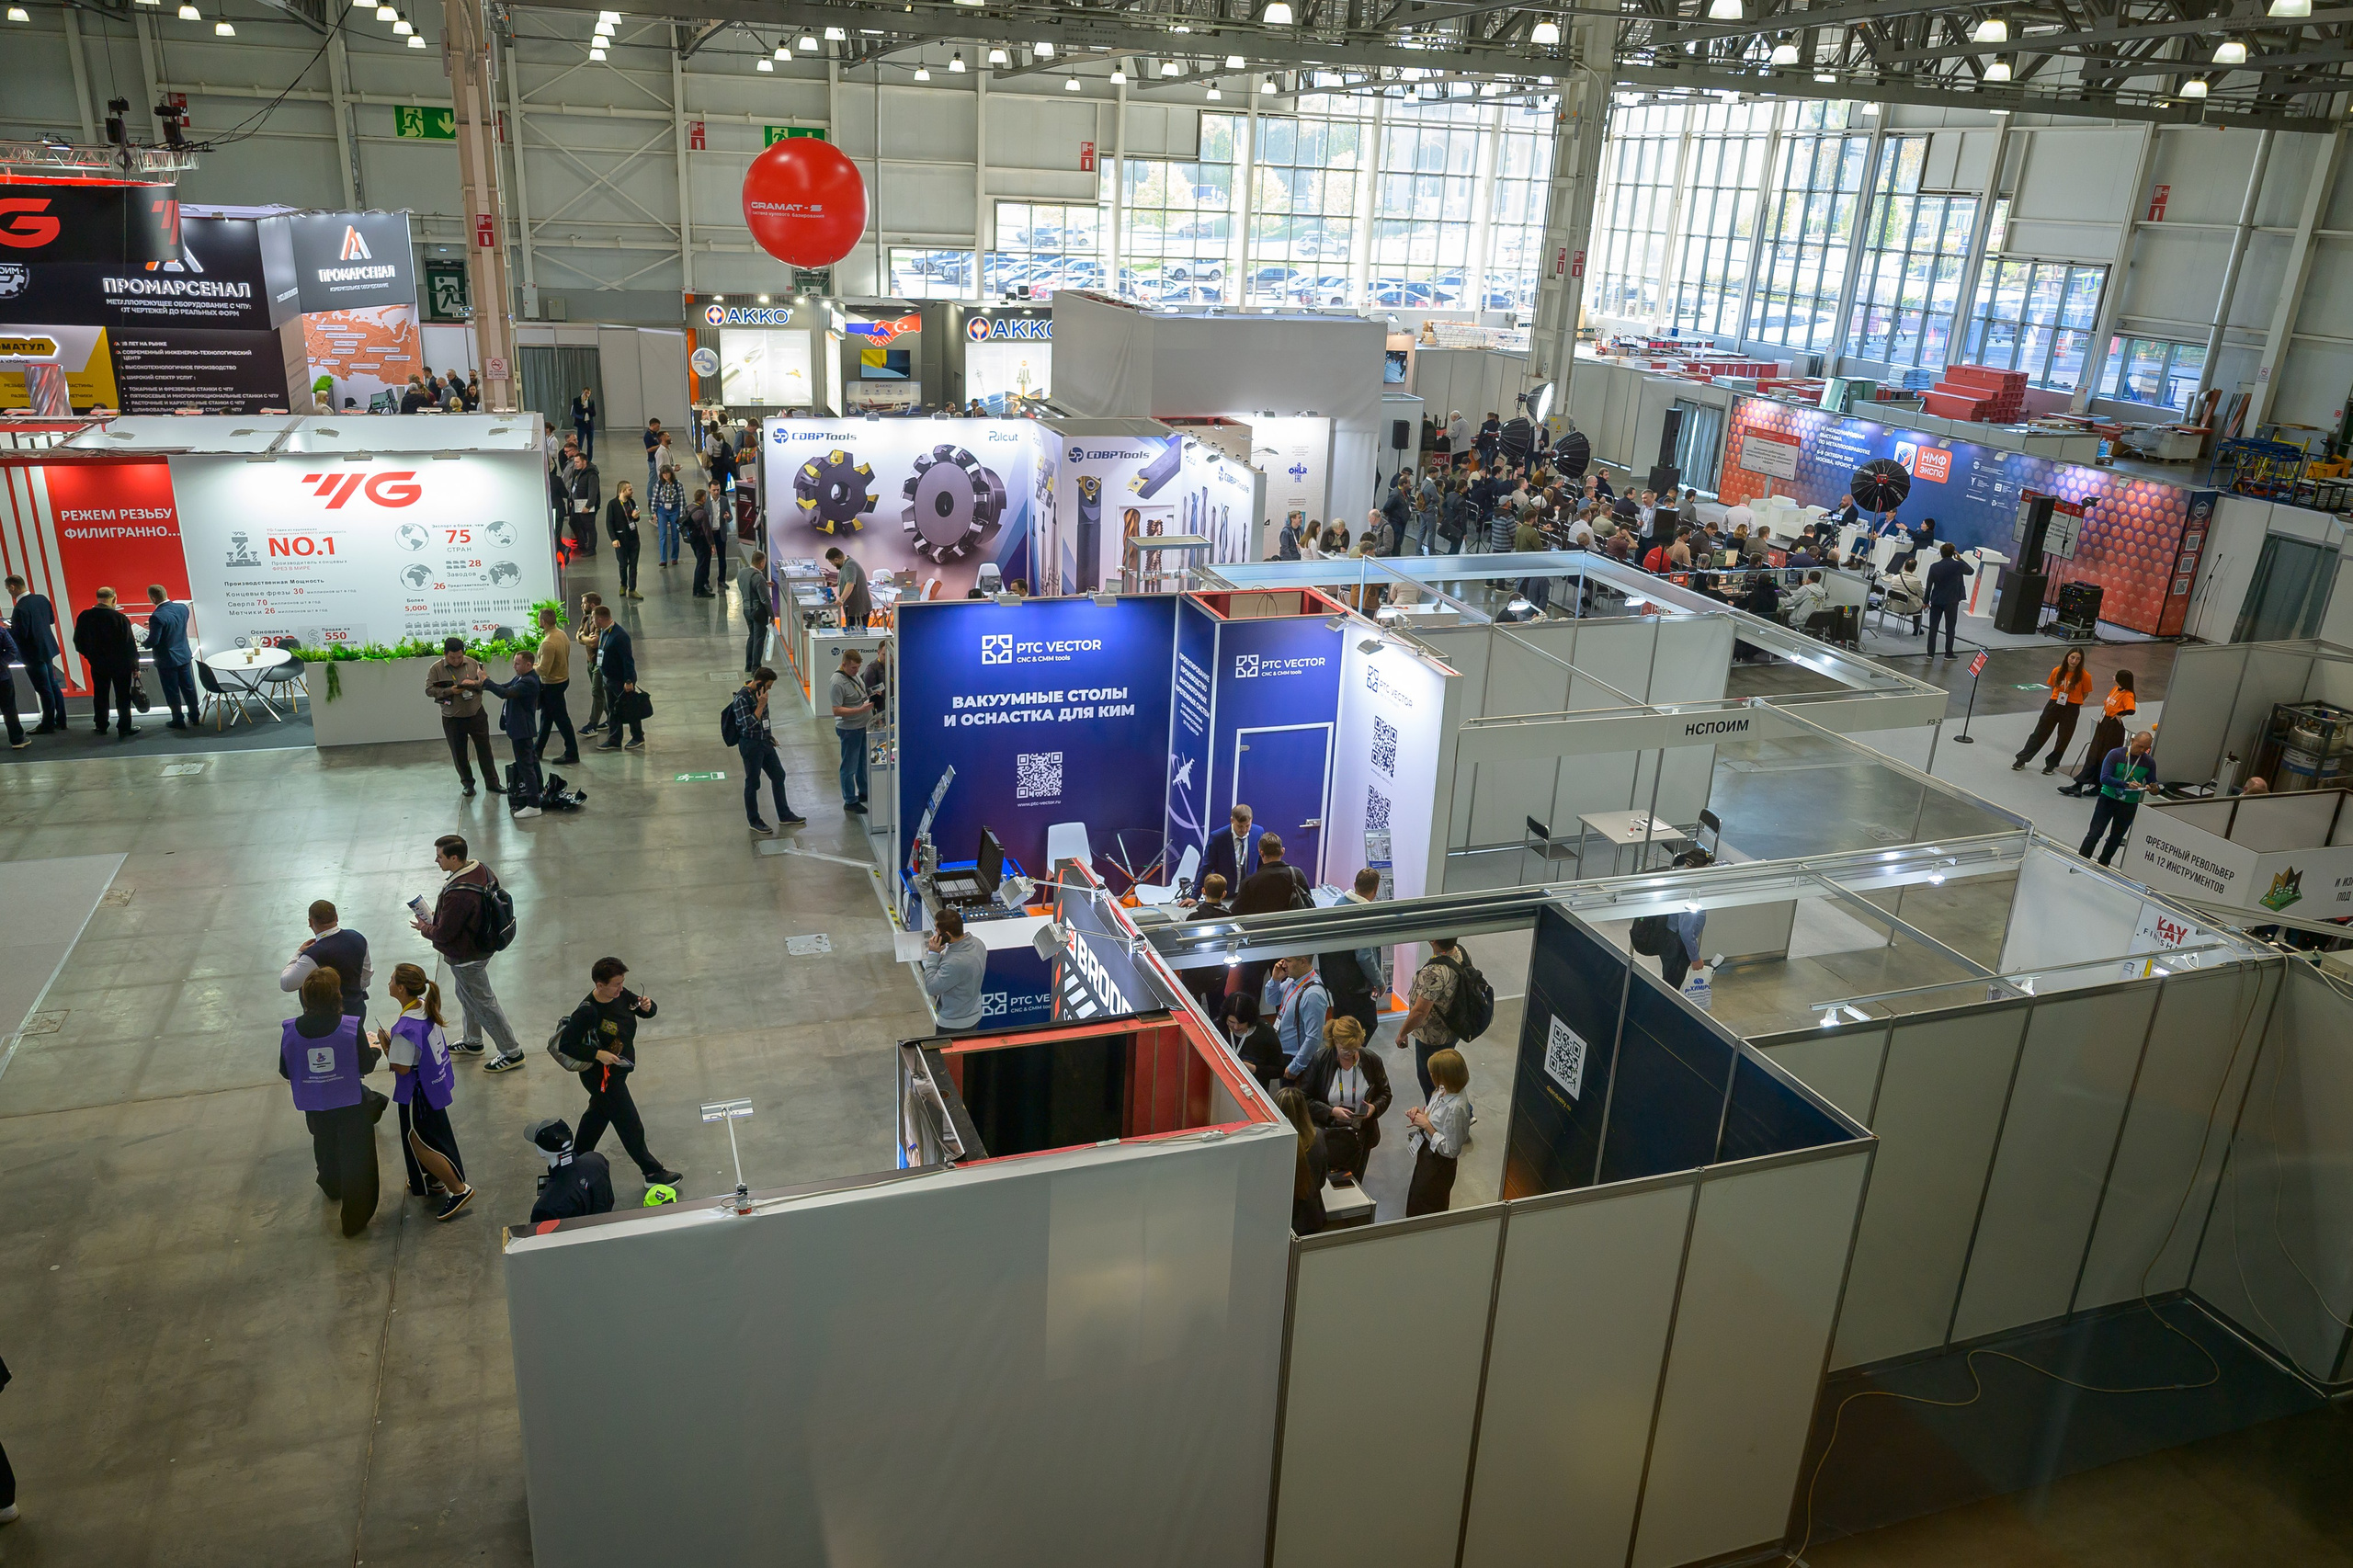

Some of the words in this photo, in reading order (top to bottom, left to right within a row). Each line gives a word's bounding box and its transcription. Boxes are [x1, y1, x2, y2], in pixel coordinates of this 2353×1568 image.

[318, 265, 396, 283] ПРОМАРСЕНАЛ
[102, 278, 252, 299] ПРОМАРСЕНАЛ
[106, 298, 173, 308] МЕТАЛЛОРЕЖУЩЕЕ
[173, 301, 229, 309] ОБОРУДОВАНИЕ
[727, 308, 790, 324] AKKO
[0, 343, 45, 351] МАТУЛ
[791, 432, 858, 441] CDBPTools
[1819, 432, 1843, 442] ВЫСТАВКА
[1825, 426, 1866, 440] МЕЖДУНАРОДНАЯ
[1086, 450, 1150, 460] CDBPTools
[1824, 450, 1844, 460] ОКТЯБРЯ
[1825, 440, 1871, 456] МЕТАЛЛООБРАБОТКЕ
[1815, 455, 1835, 466] МОСКВА,
[1835, 460, 1852, 470] КРОКУС
[1921, 451, 1948, 467] НМФ
[1919, 467, 1945, 479] ЭКСПО
[61, 509, 116, 522] РЕЖЕМ
[119, 507, 173, 521] РЕЗЬБУ
[63, 525, 181, 540] ФИЛИГРАННО...
[445, 529, 472, 544] 75
[267, 536, 335, 557] NO.1
[468, 559, 482, 567] 28
[324, 631, 347, 640] 550
[1016, 642, 1043, 654] PTC
[1045, 639, 1102, 653] VECTOR
[1261, 659, 1282, 670] PTC
[1283, 656, 1326, 669] VECTOR
[951, 690, 1064, 710] ВАКУУМНЫЕ
[1067, 687, 1129, 702] СТОЛЫ
[1391, 688, 1413, 710] VECTOR
[943, 714, 957, 727] И
[961, 709, 1054, 726] ОСНАСТКА
[1057, 706, 1094, 722] ДЛЯ
[1097, 704, 1135, 718] КИМ
[1685, 719, 1750, 736] НСПОИМ
[1017, 799, 1062, 808] www.ptc-vector.ru
[2144, 835, 2190, 862] ФРЕЗЕРНЫЙ
[2190, 854, 2235, 882] РЕВОЛЬВЕР
[2143, 850, 2154, 863] НА
[2156, 855, 2165, 868] 12
[2165, 858, 2225, 894] ИНСТРУМЕНТОВ
[2335, 877, 2341, 888] И
[2336, 891, 2352, 902] ПОД
[2156, 915, 2189, 946] KAY
[1010, 995, 1033, 1006] PTC
[1036, 994, 1051, 1004] VE
